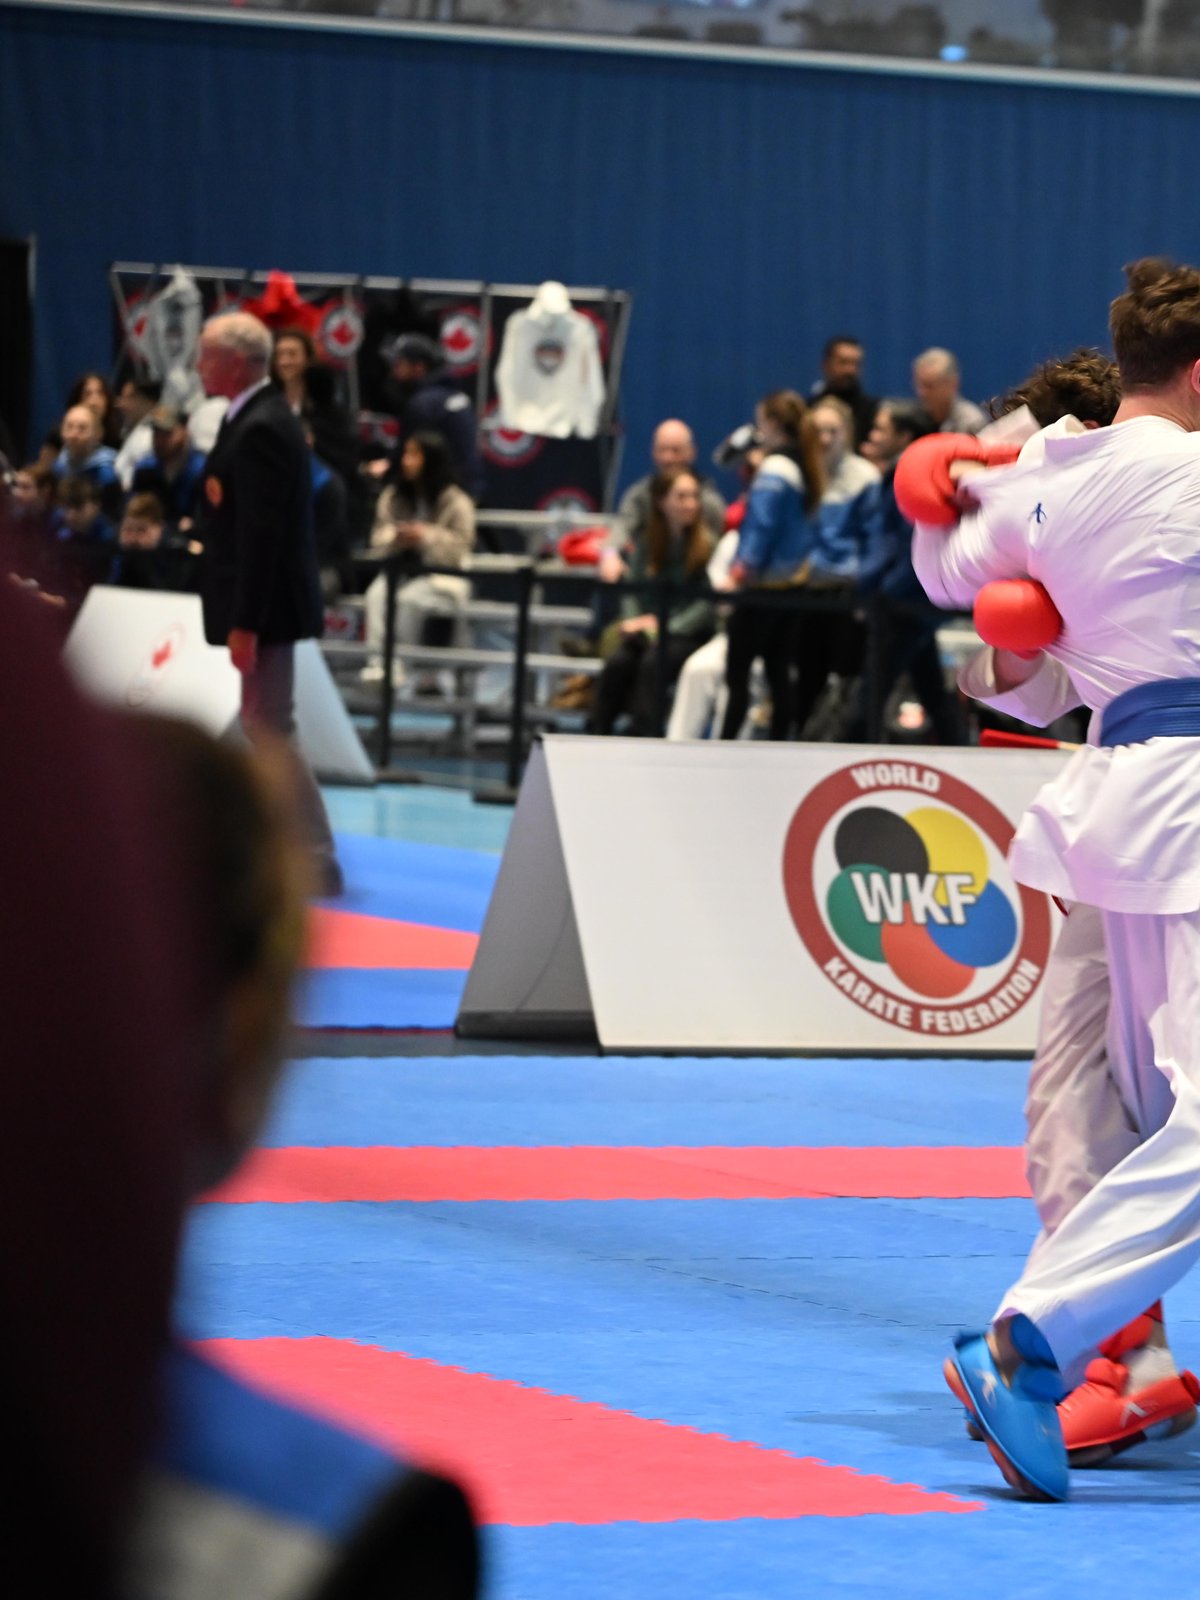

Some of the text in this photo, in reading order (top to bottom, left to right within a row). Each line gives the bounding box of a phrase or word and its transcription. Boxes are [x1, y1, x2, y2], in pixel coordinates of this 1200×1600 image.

[851, 763, 941, 793] WORLD
[850, 872, 977, 925] WKF
[823, 955, 1041, 1033] KARATE FEDERATION
